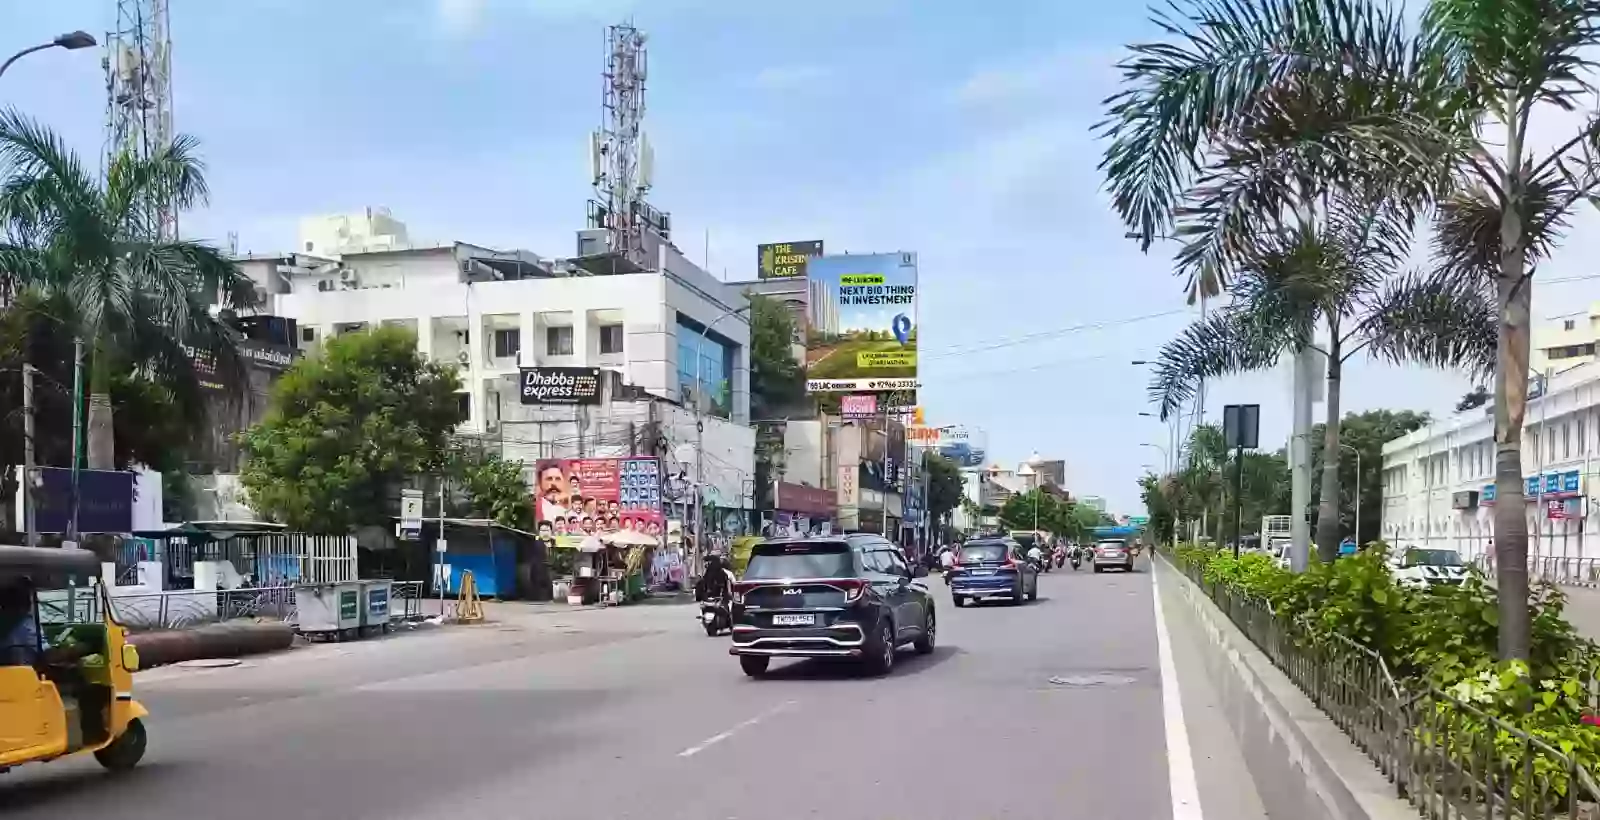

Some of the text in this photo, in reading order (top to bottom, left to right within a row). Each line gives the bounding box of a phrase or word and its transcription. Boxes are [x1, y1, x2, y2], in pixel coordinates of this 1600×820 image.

[775, 244, 792, 253] THE
[775, 266, 797, 276] CAFE
[839, 286, 865, 295] NEXT
[886, 285, 915, 295] THING
[839, 295, 913, 305] IN INVESTMENT
[526, 371, 575, 385] Dhabba
[523, 386, 573, 399] express
